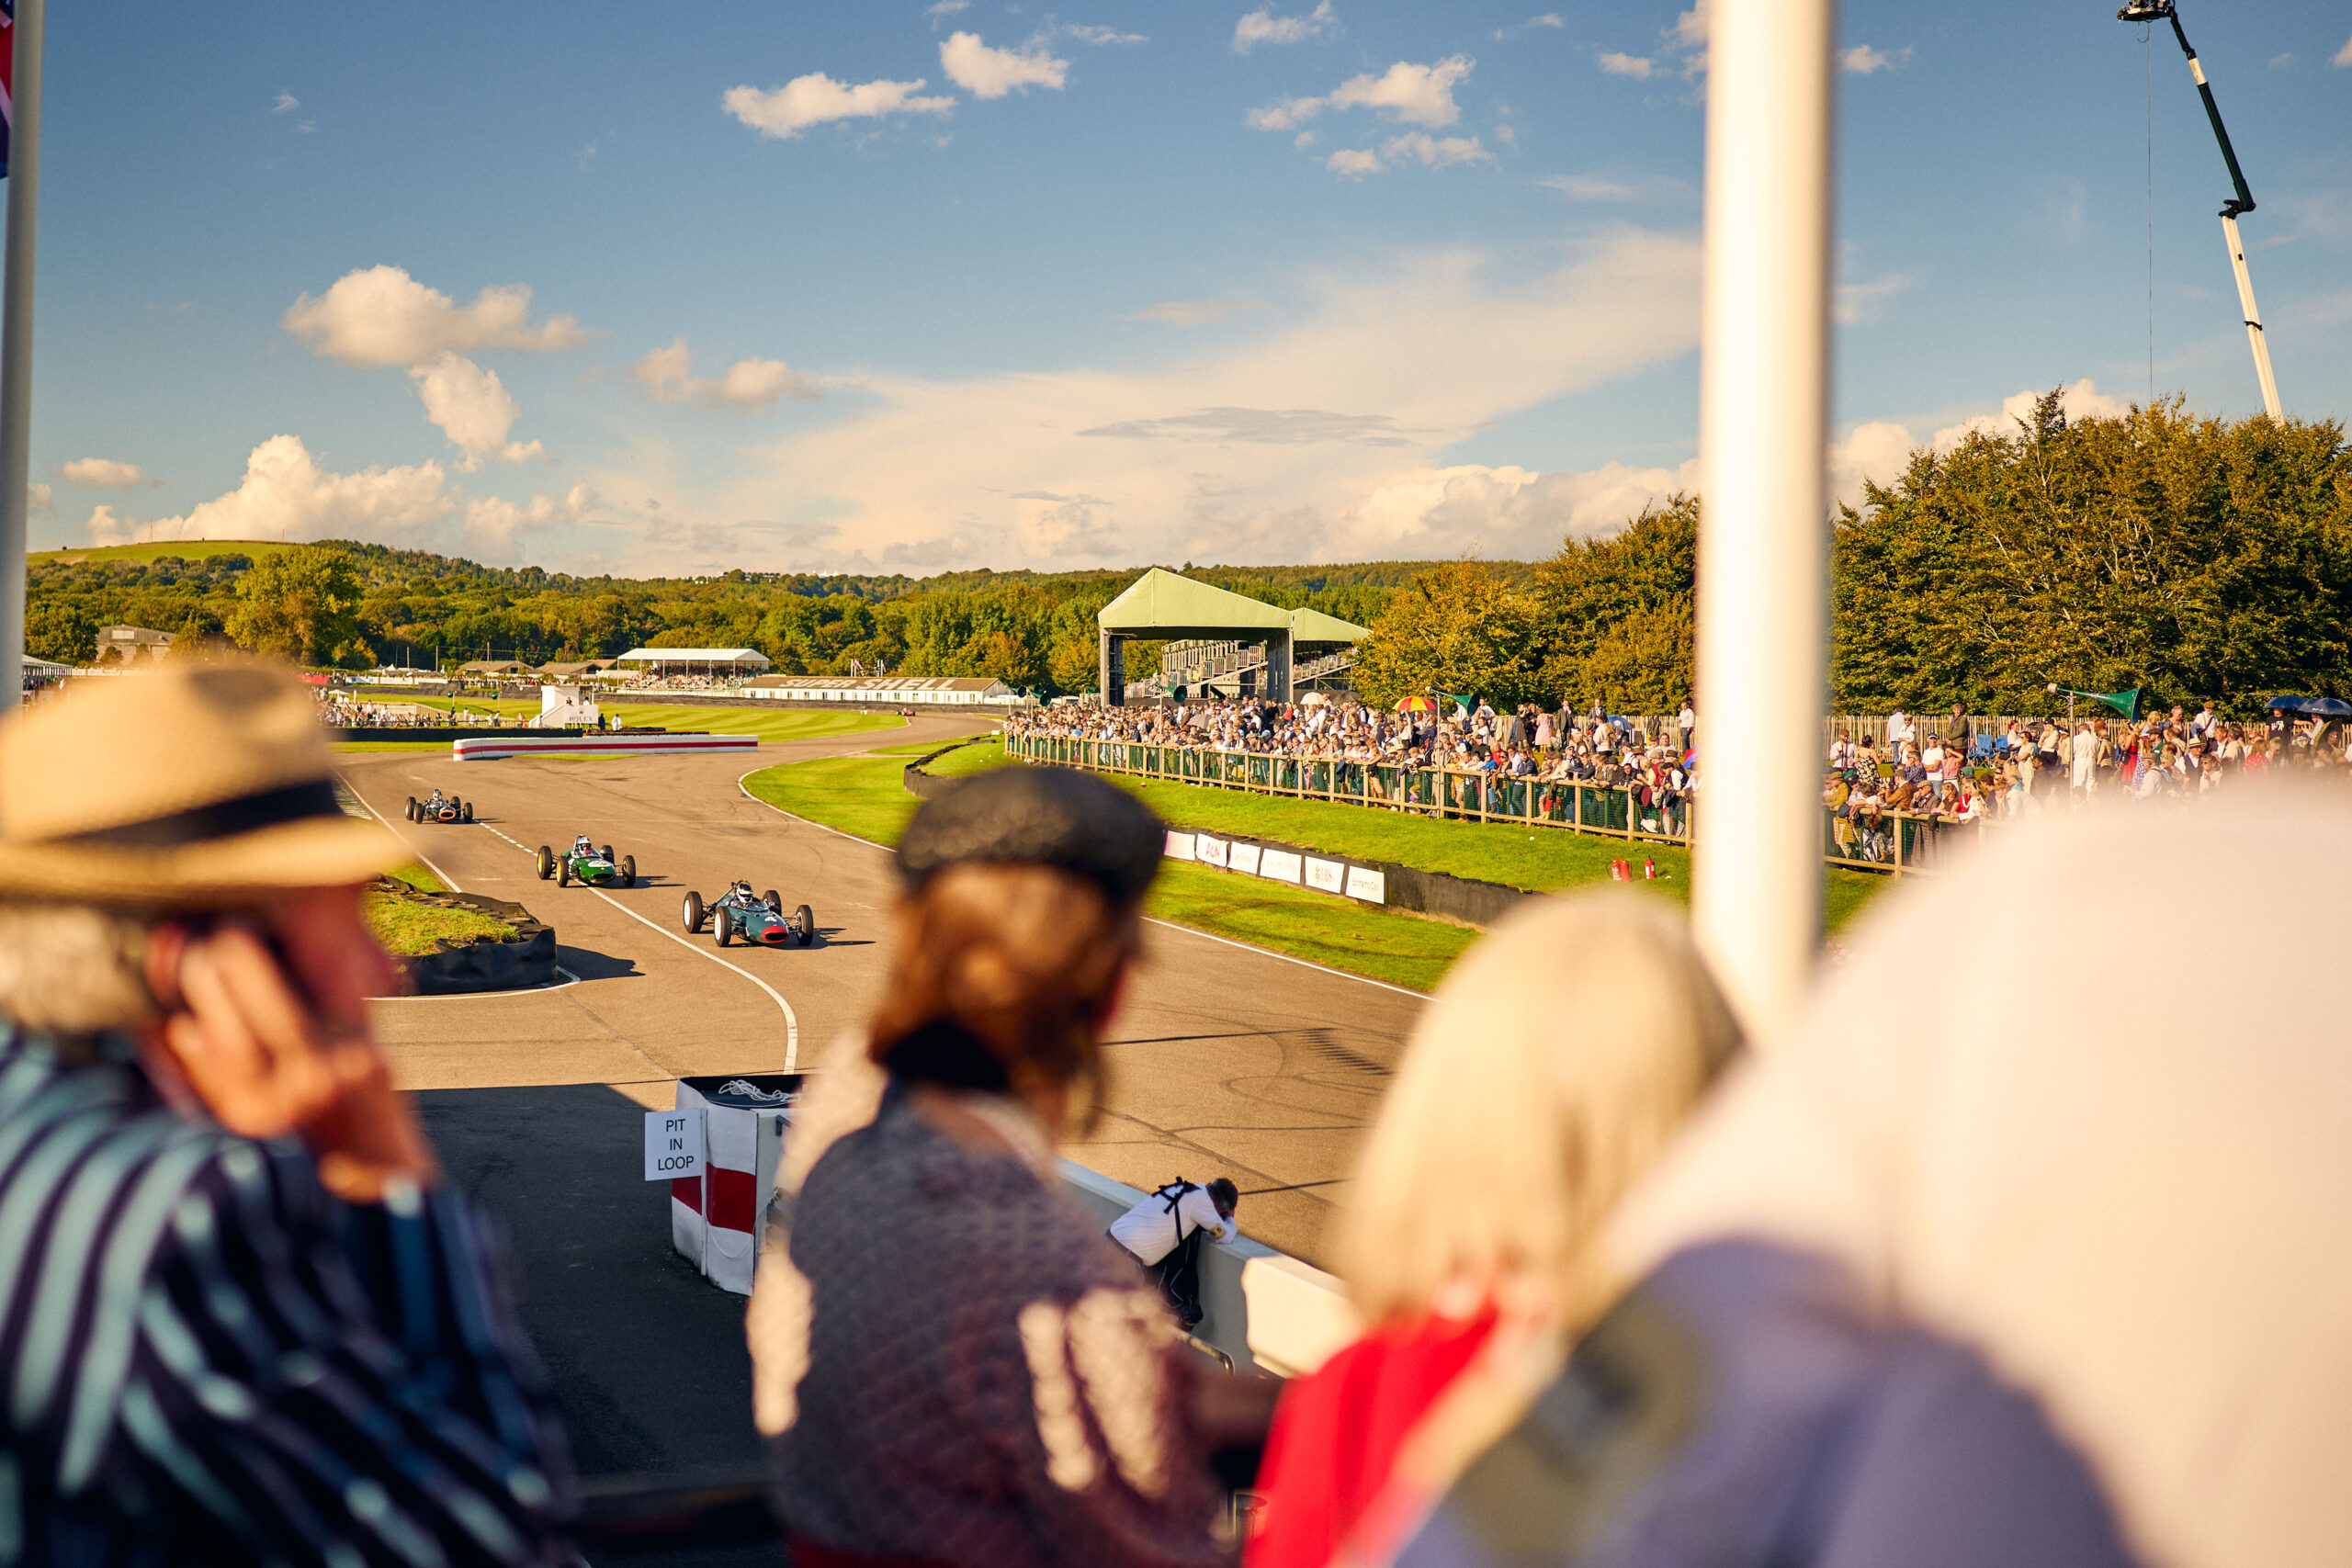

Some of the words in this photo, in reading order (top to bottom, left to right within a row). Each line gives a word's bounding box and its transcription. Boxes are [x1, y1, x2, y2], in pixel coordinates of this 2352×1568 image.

[779, 679, 856, 688] SUPER
[855, 679, 956, 691] SHELL
[666, 1119, 686, 1132] PIT
[670, 1138, 683, 1150] IN
[658, 1156, 695, 1170] LOOP
